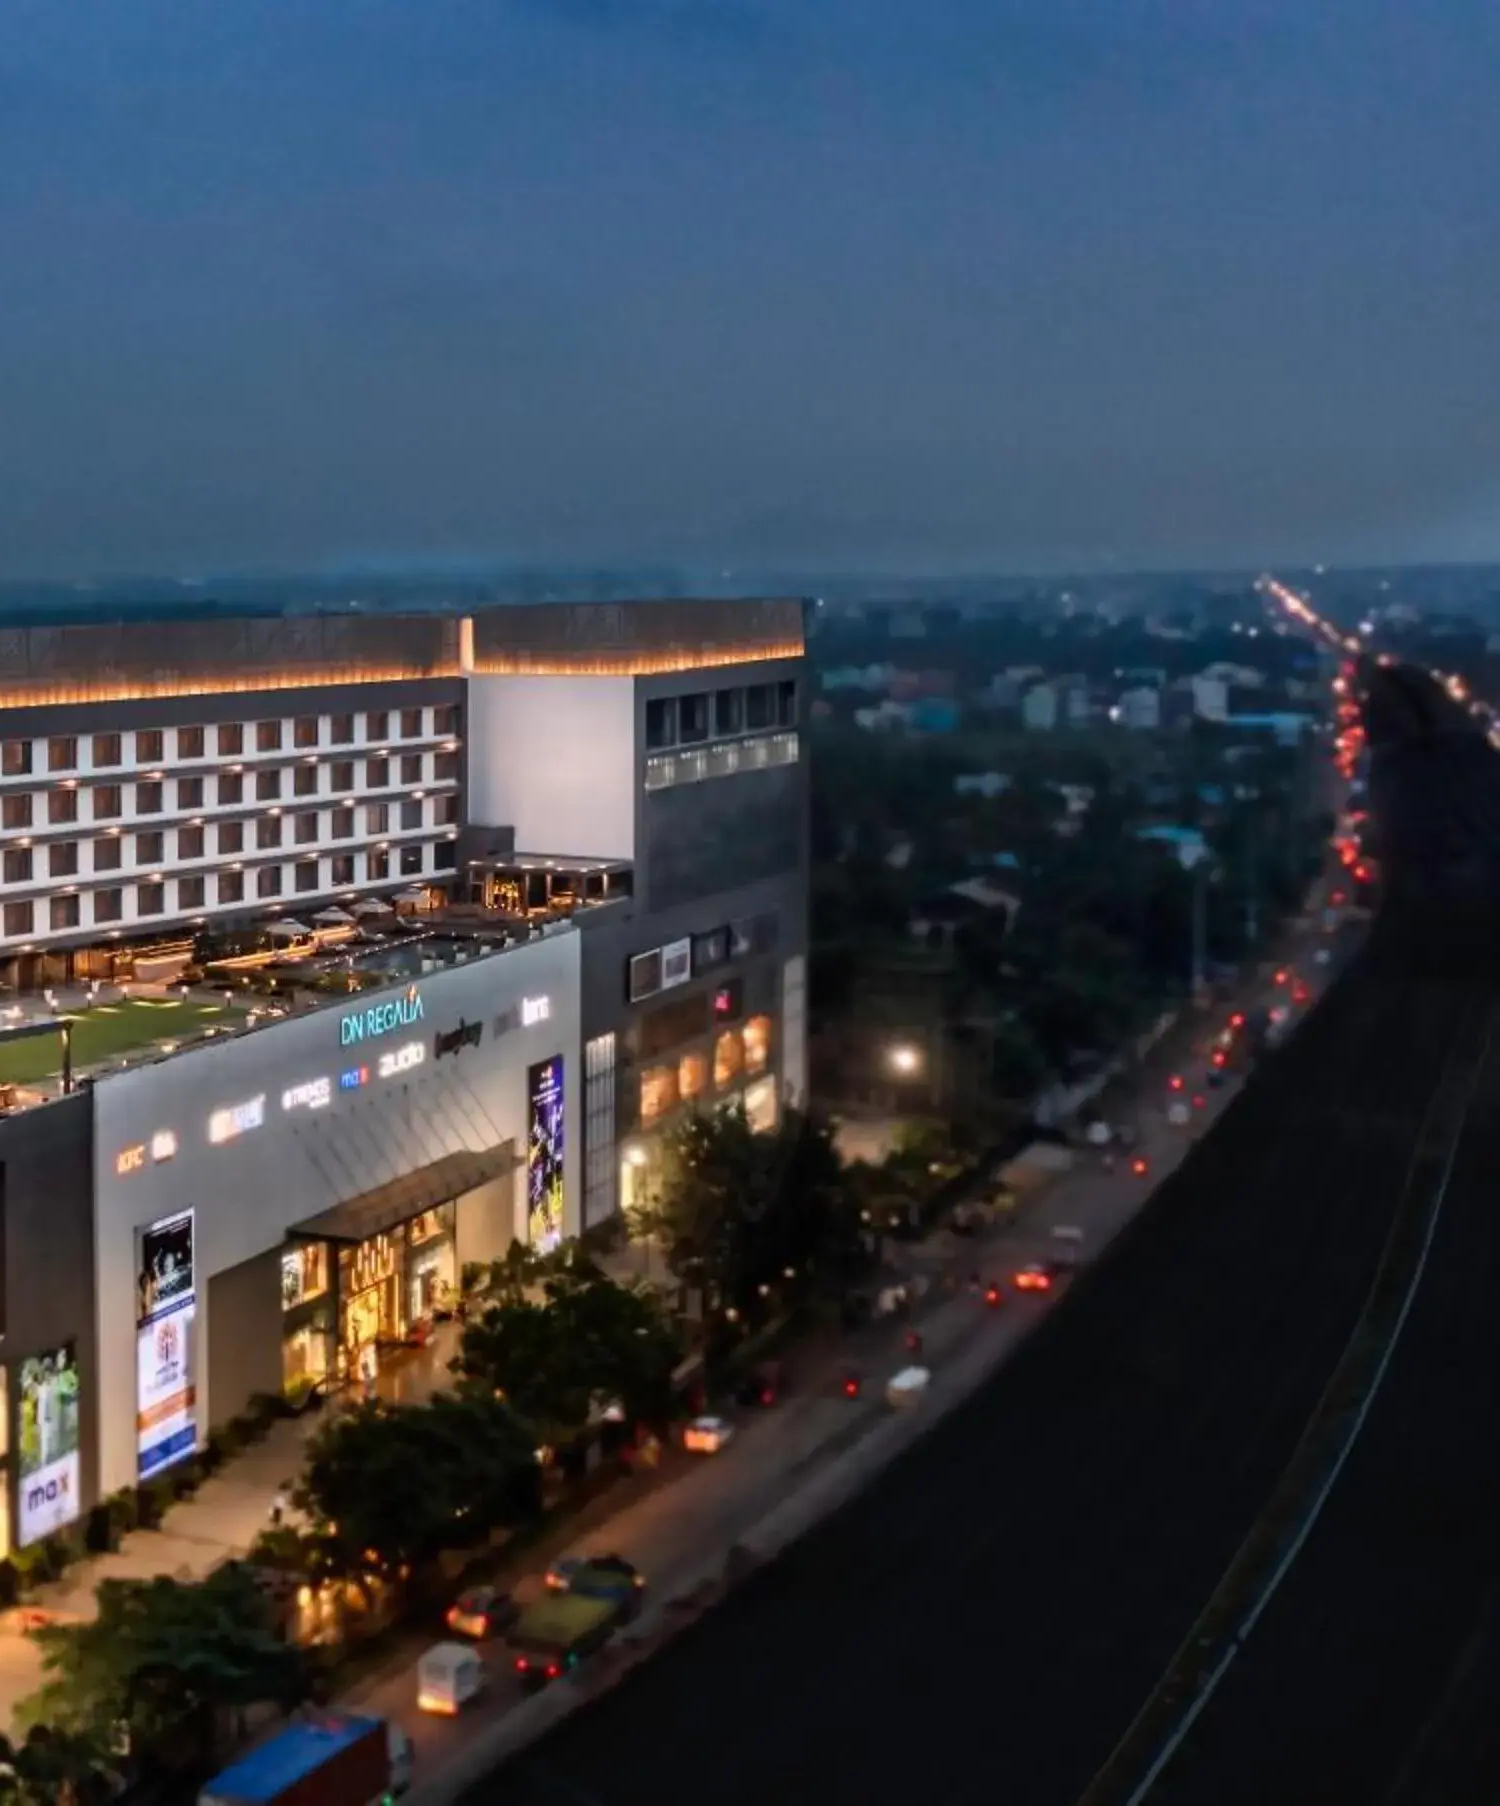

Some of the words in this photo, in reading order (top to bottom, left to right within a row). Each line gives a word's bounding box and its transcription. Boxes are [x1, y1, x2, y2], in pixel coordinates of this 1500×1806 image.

[340, 1013, 363, 1046] DN
[366, 993, 425, 1037] REGALIA
[28, 1472, 69, 1512] max
